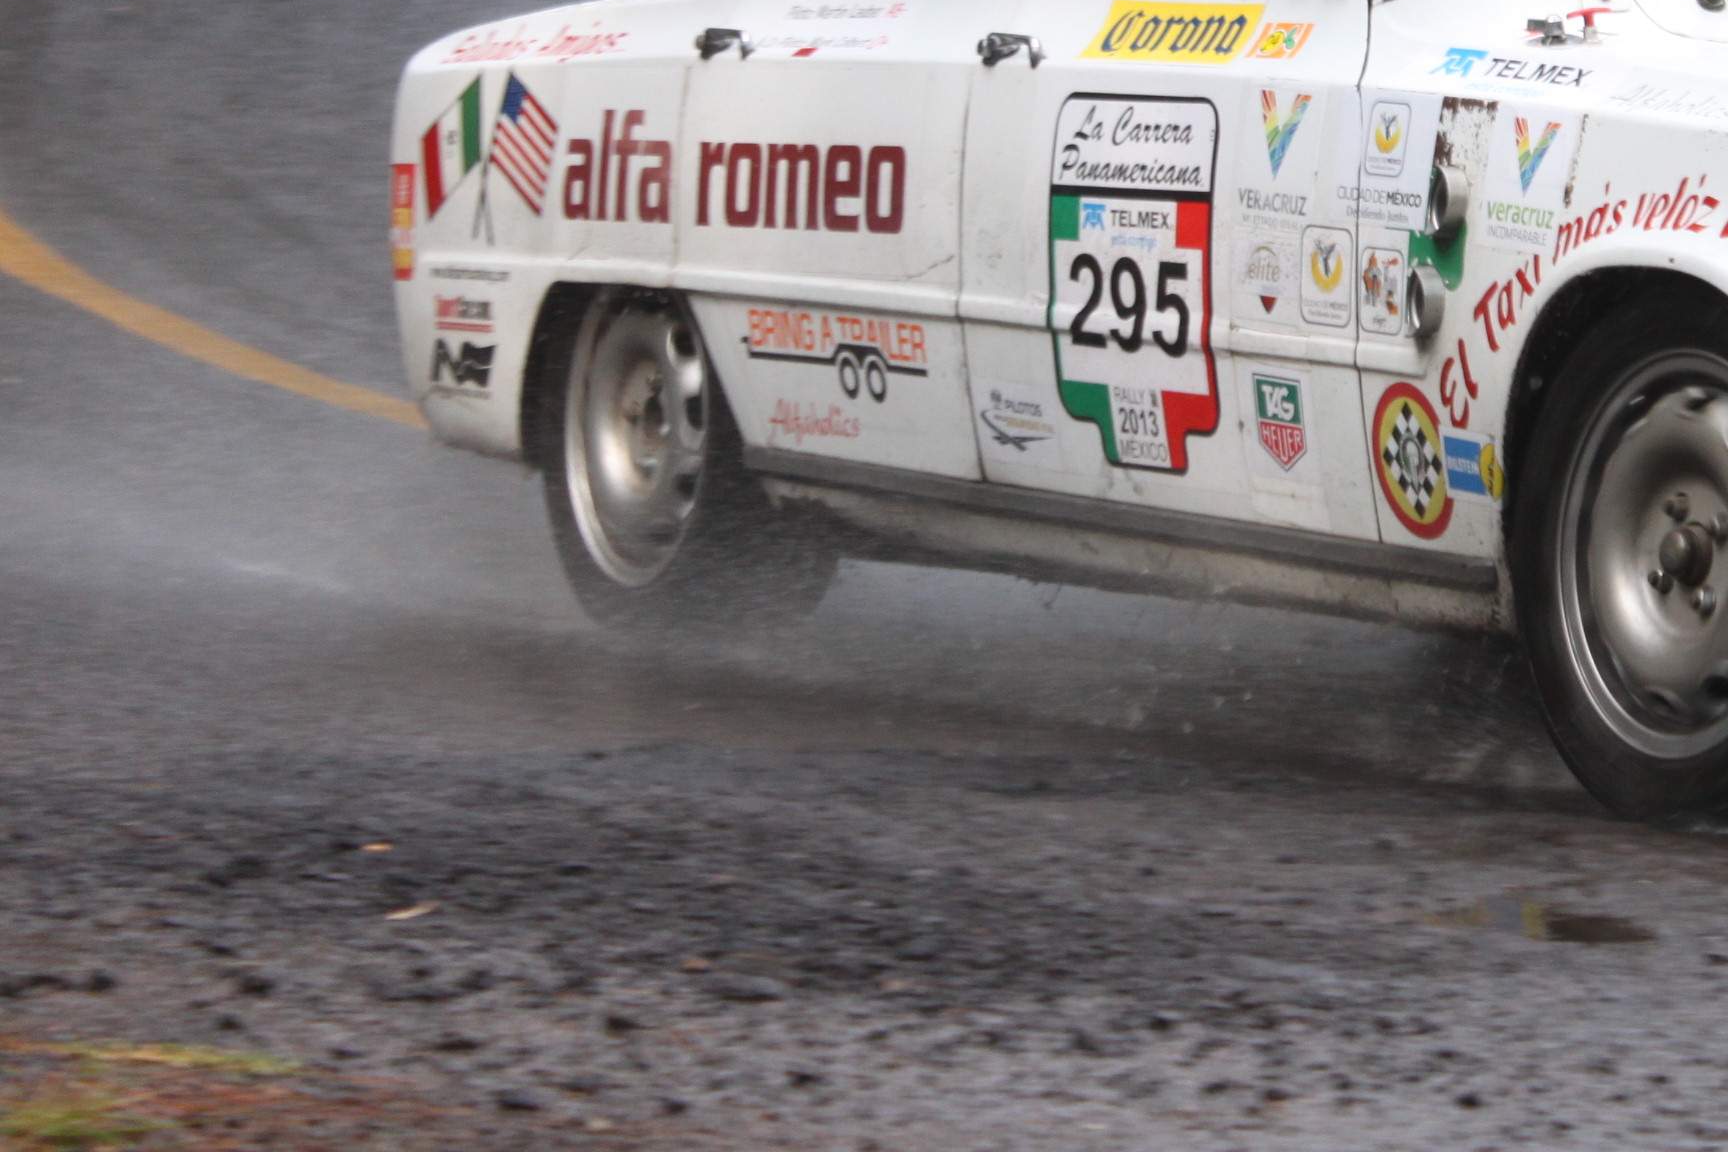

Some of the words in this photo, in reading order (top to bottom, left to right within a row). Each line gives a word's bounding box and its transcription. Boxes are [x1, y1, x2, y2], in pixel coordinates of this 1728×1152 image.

[1101, 10, 1247, 56] Corona
[1484, 57, 1594, 88] TELMEX
[1073, 104, 1103, 142] La
[1112, 105, 1194, 147] Carrera
[563, 109, 673, 224] alfa
[695, 140, 907, 234] romeo
[1059, 143, 1203, 186] Panamericana
[1238, 188, 1307, 216] VERACRUZ
[1386, 188, 1422, 208] MÉXICO
[1487, 200, 1555, 229] veracruz
[1111, 209, 1170, 230] TELMEX
[1487, 224, 1548, 247] INCOMPARABLE
[1069, 253, 1190, 358] 295
[1439, 338, 1479, 429] El
[1473, 255, 1543, 353] Taxi
[1552, 181, 1628, 267] más
[1632, 174, 1721, 234] velóz
[747, 308, 816, 351] BRING
[820, 315, 838, 353] A
[836, 316, 929, 364] TRAILER
[1114, 386, 1147, 404] RALLY
[1262, 382, 1296, 422] TAG
[1118, 407, 1160, 437] 2013
[1261, 422, 1304, 463] HEUER
[1446, 455, 1481, 476] BILSTEIN
